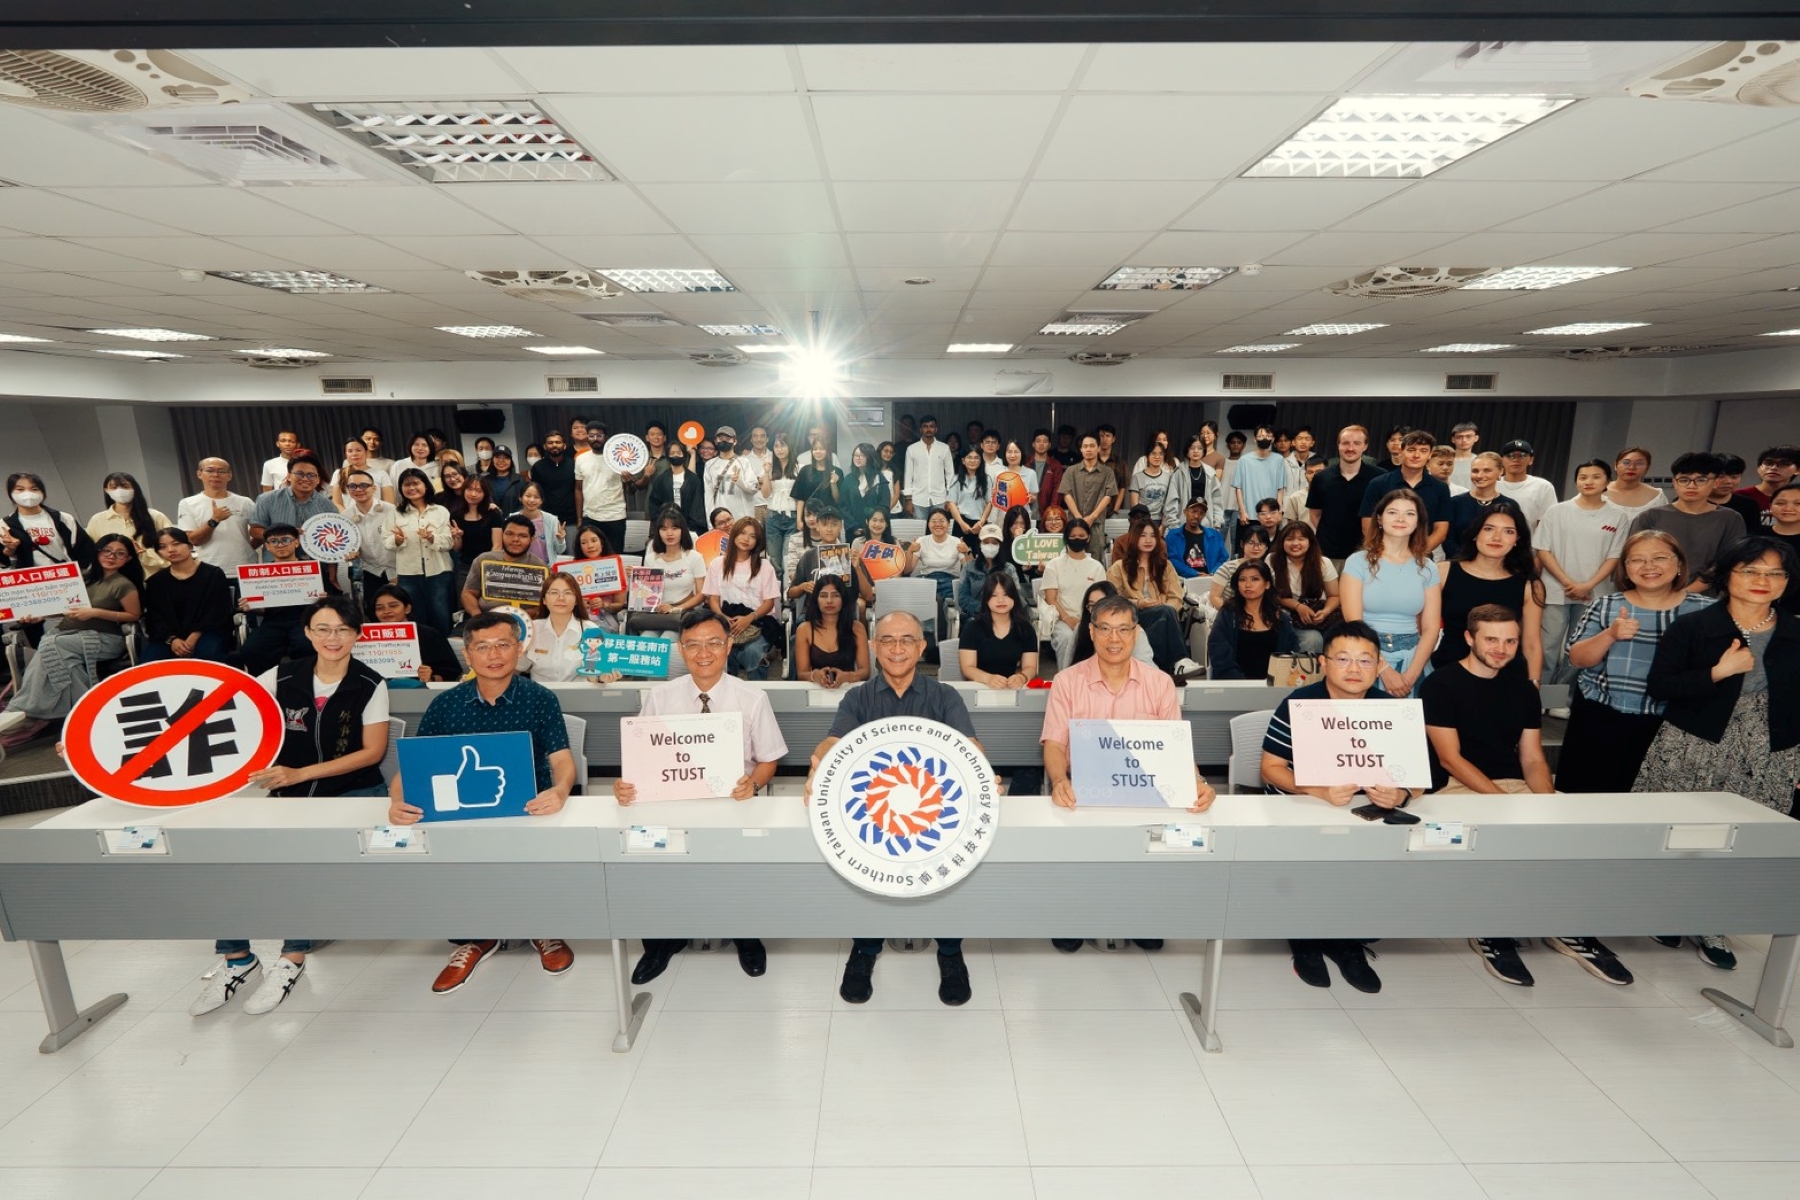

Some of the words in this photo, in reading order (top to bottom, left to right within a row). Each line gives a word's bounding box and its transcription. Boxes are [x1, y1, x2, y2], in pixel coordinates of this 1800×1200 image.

[1026, 539, 1030, 548] I
[1034, 538, 1059, 549] LOVE
[1026, 550, 1059, 560] Taiwan
[0, 567, 71, 586] 制人口販運
[248, 565, 313, 577] 防制人口販運
[604, 638, 668, 653] 移民署臺南市
[607, 652, 661, 667] 第一服務站
[871, 722, 923, 737] Science
[1321, 716, 1393, 730] Welcome
[333, 709, 351, 758] 外事警
[649, 731, 715, 746] Welcome
[855, 731, 868, 745] of
[926, 727, 952, 742] and
[1098, 736, 1164, 750] Welcome
[1350, 736, 1367, 749] to
[675, 751, 691, 763] to
[1124, 756, 1140, 769] to
[1336, 753, 1385, 768] STUST
[661, 767, 706, 782] STUST
[817, 744, 854, 807] University
[953, 738, 991, 809] Technology
[1111, 773, 1156, 788] STUST
[820, 811, 846, 860] Taiwan
[918, 812, 992, 886] 南臺科技大學
[848, 857, 914, 886] Southern
